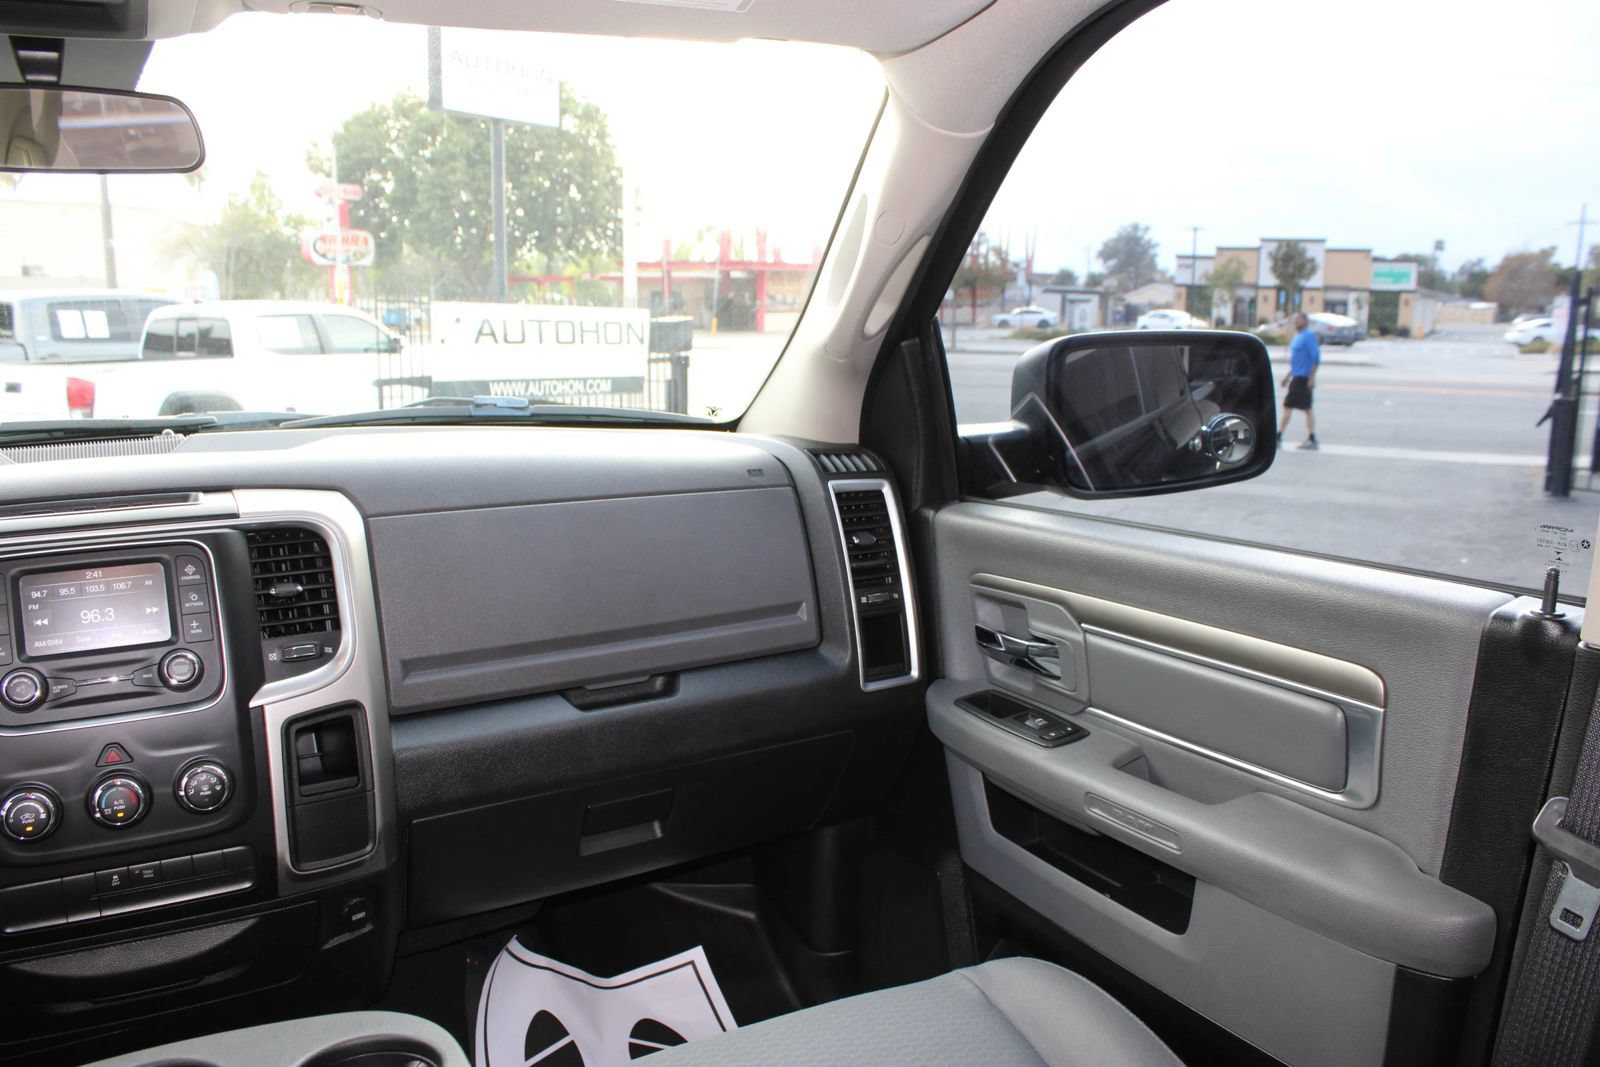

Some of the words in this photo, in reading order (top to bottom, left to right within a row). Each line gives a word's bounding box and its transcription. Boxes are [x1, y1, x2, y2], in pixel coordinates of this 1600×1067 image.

[474, 318, 645, 345] AUTOHON
[488, 379, 612, 397] WWW.AUTOHON.COM
[85, 570, 103, 579] 2:41
[31, 589, 48, 599] 94.7
[86, 584, 105, 593] 103.5
[112, 581, 132, 590] 106.7
[80, 607, 115, 624] 96.3
